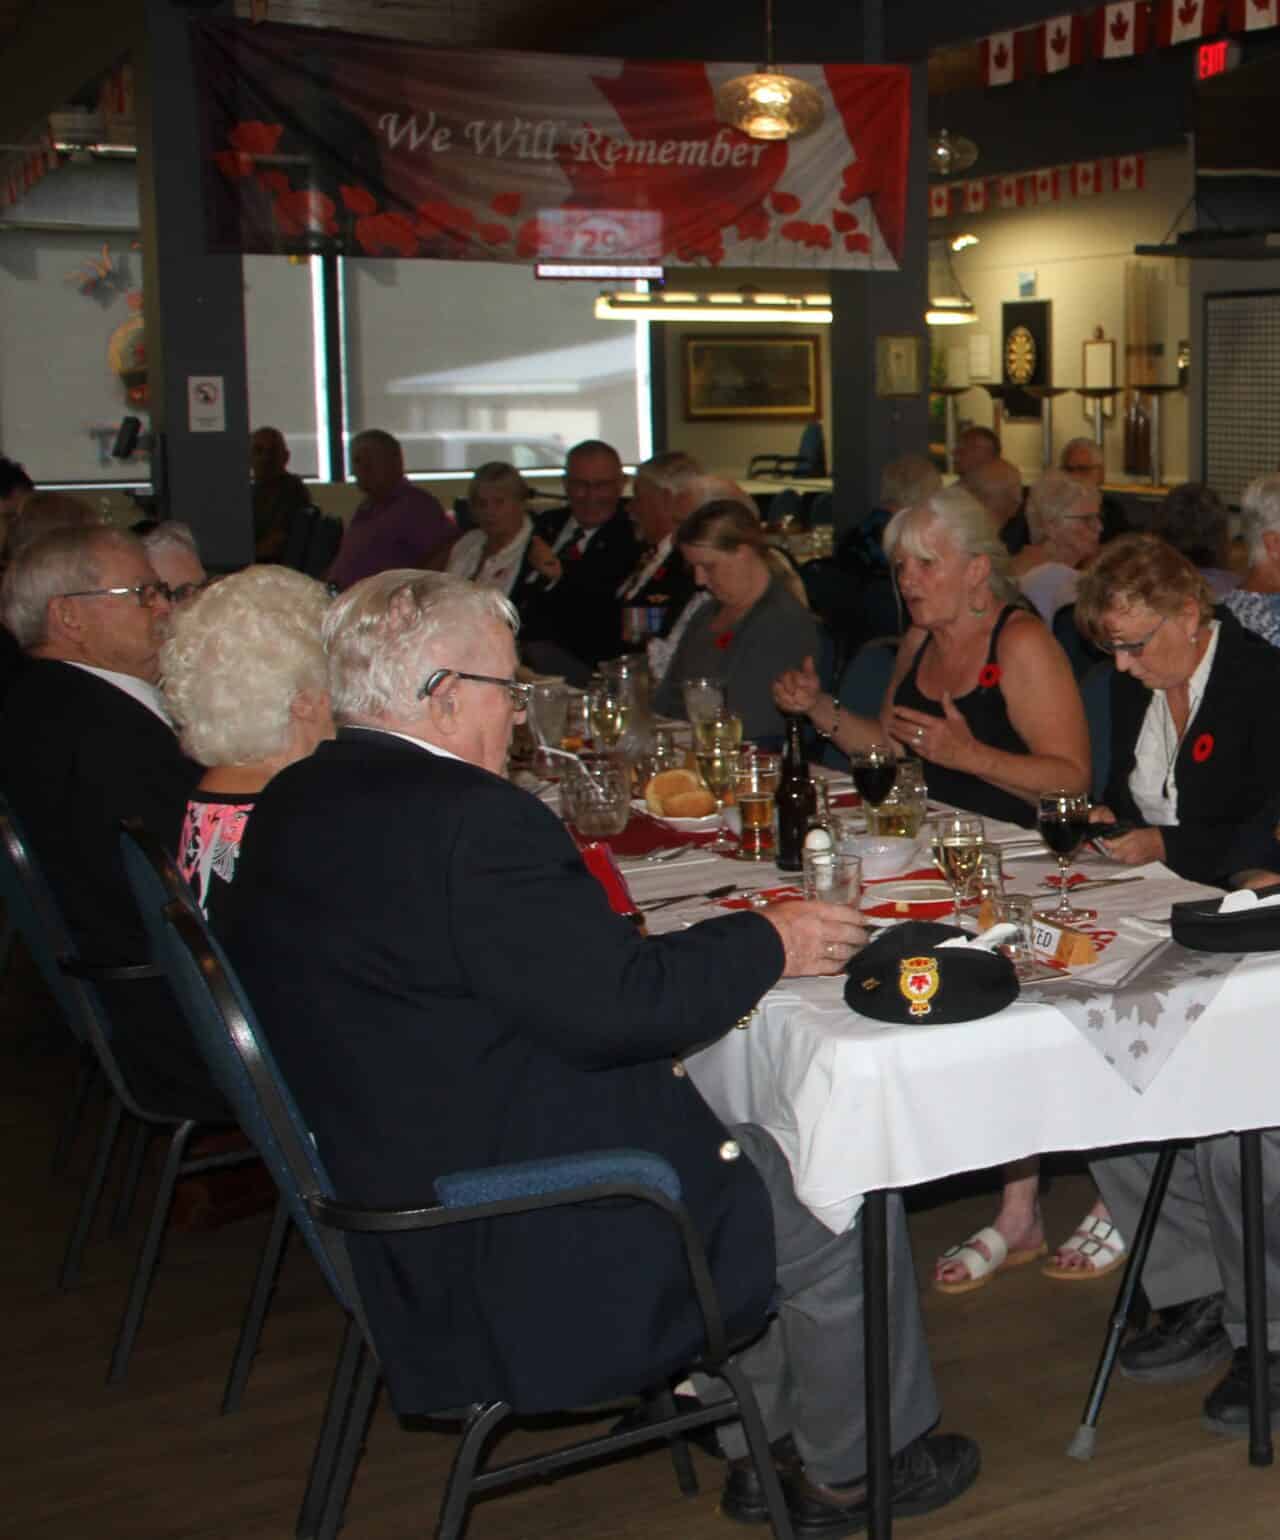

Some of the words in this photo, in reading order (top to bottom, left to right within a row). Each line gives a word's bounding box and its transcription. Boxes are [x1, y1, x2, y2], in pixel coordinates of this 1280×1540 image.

[1198, 41, 1228, 80] EXIT
[378, 111, 451, 153] We
[464, 116, 560, 161] Will
[569, 127, 768, 170] Remember
